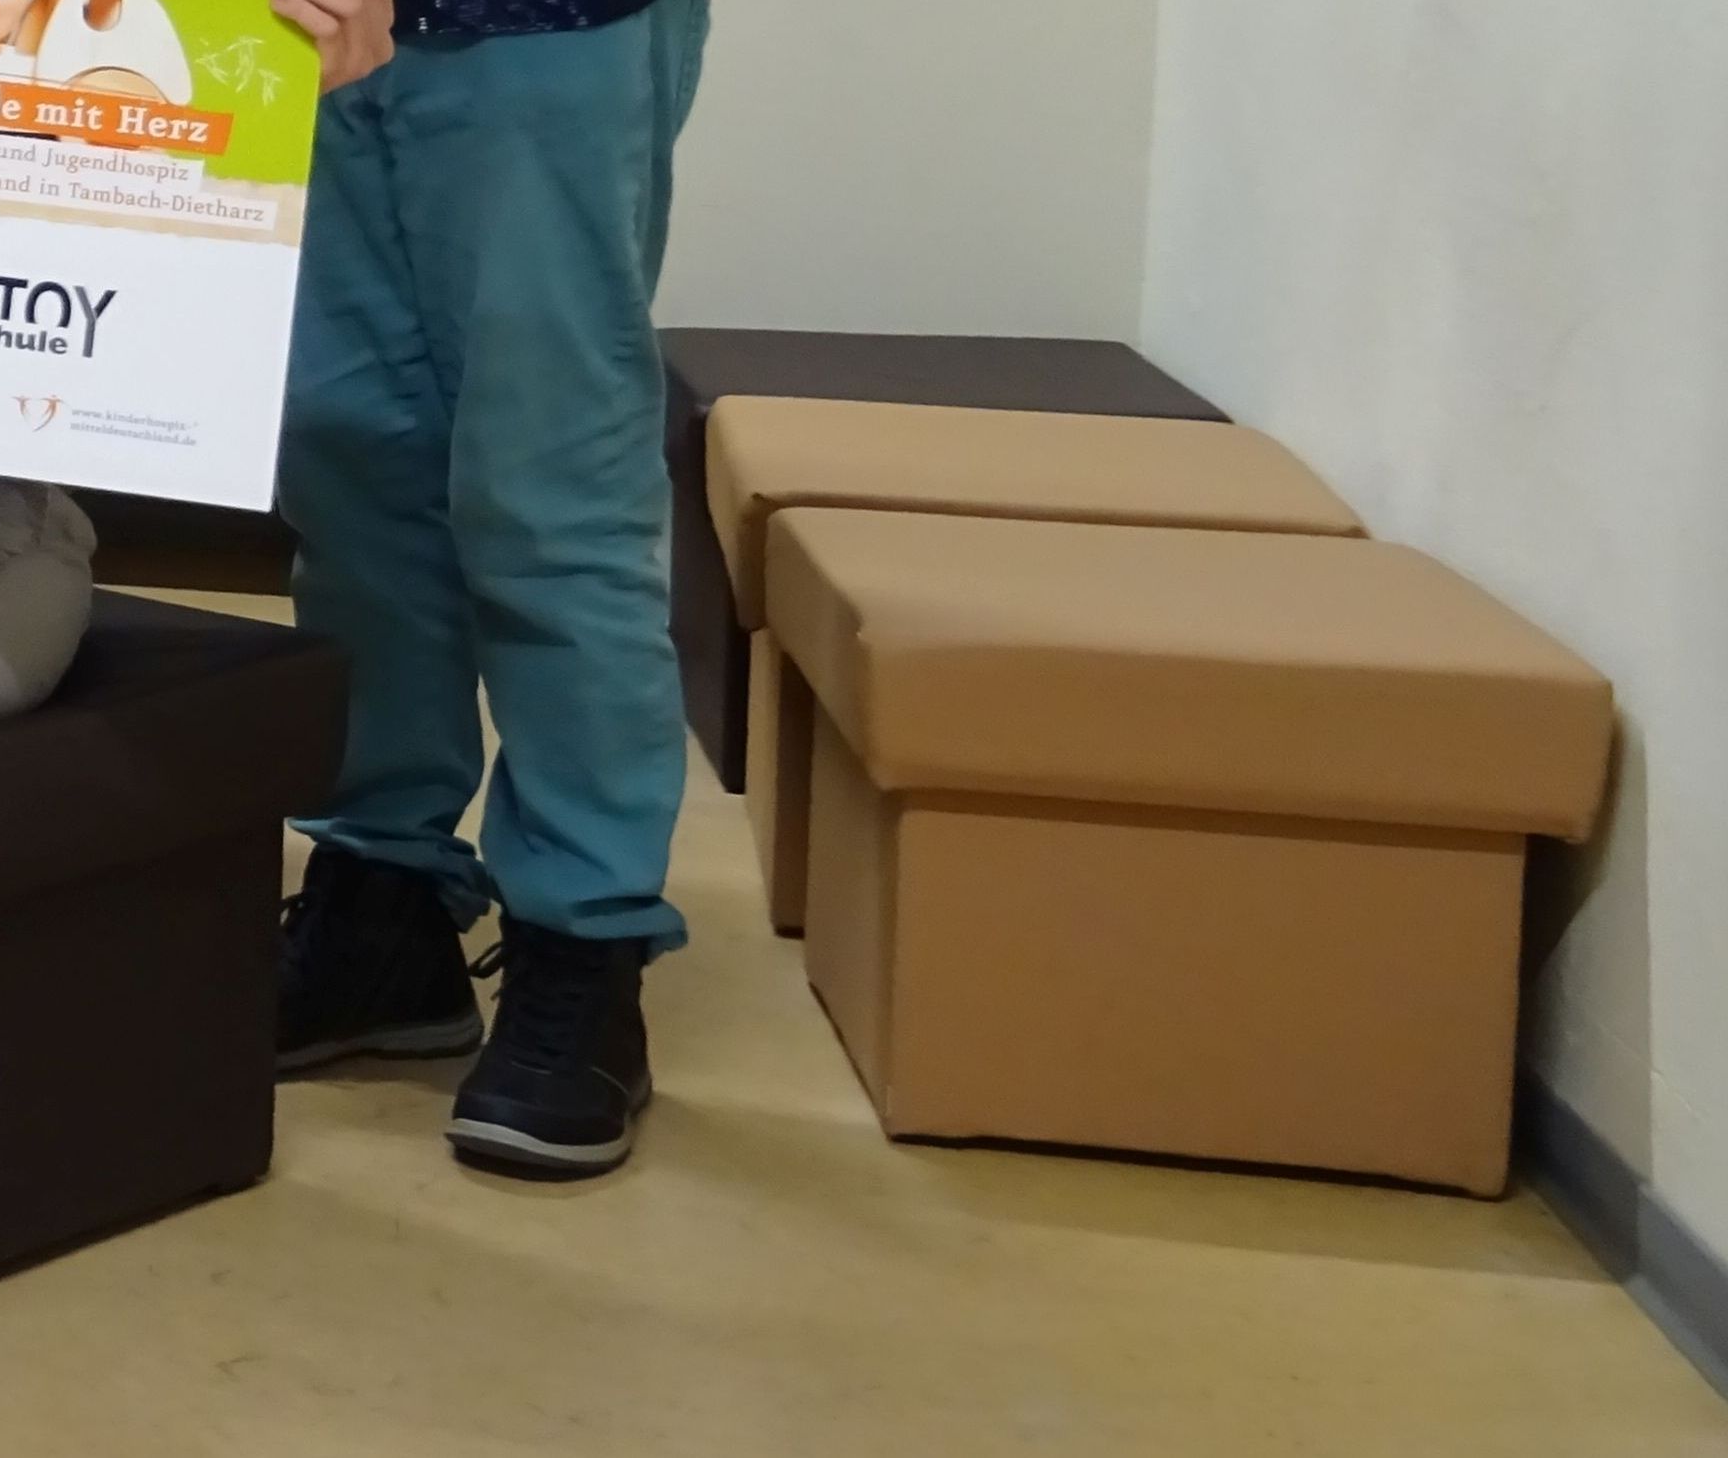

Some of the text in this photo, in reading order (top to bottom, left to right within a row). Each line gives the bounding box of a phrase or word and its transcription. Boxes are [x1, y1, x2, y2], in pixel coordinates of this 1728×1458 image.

[34, 96, 103, 132] mit
[116, 105, 210, 144] Herz
[42, 147, 190, 183] Jugendhospiz
[39, 177, 60, 196] in
[67, 182, 266, 223] Tambach-Dietharz
